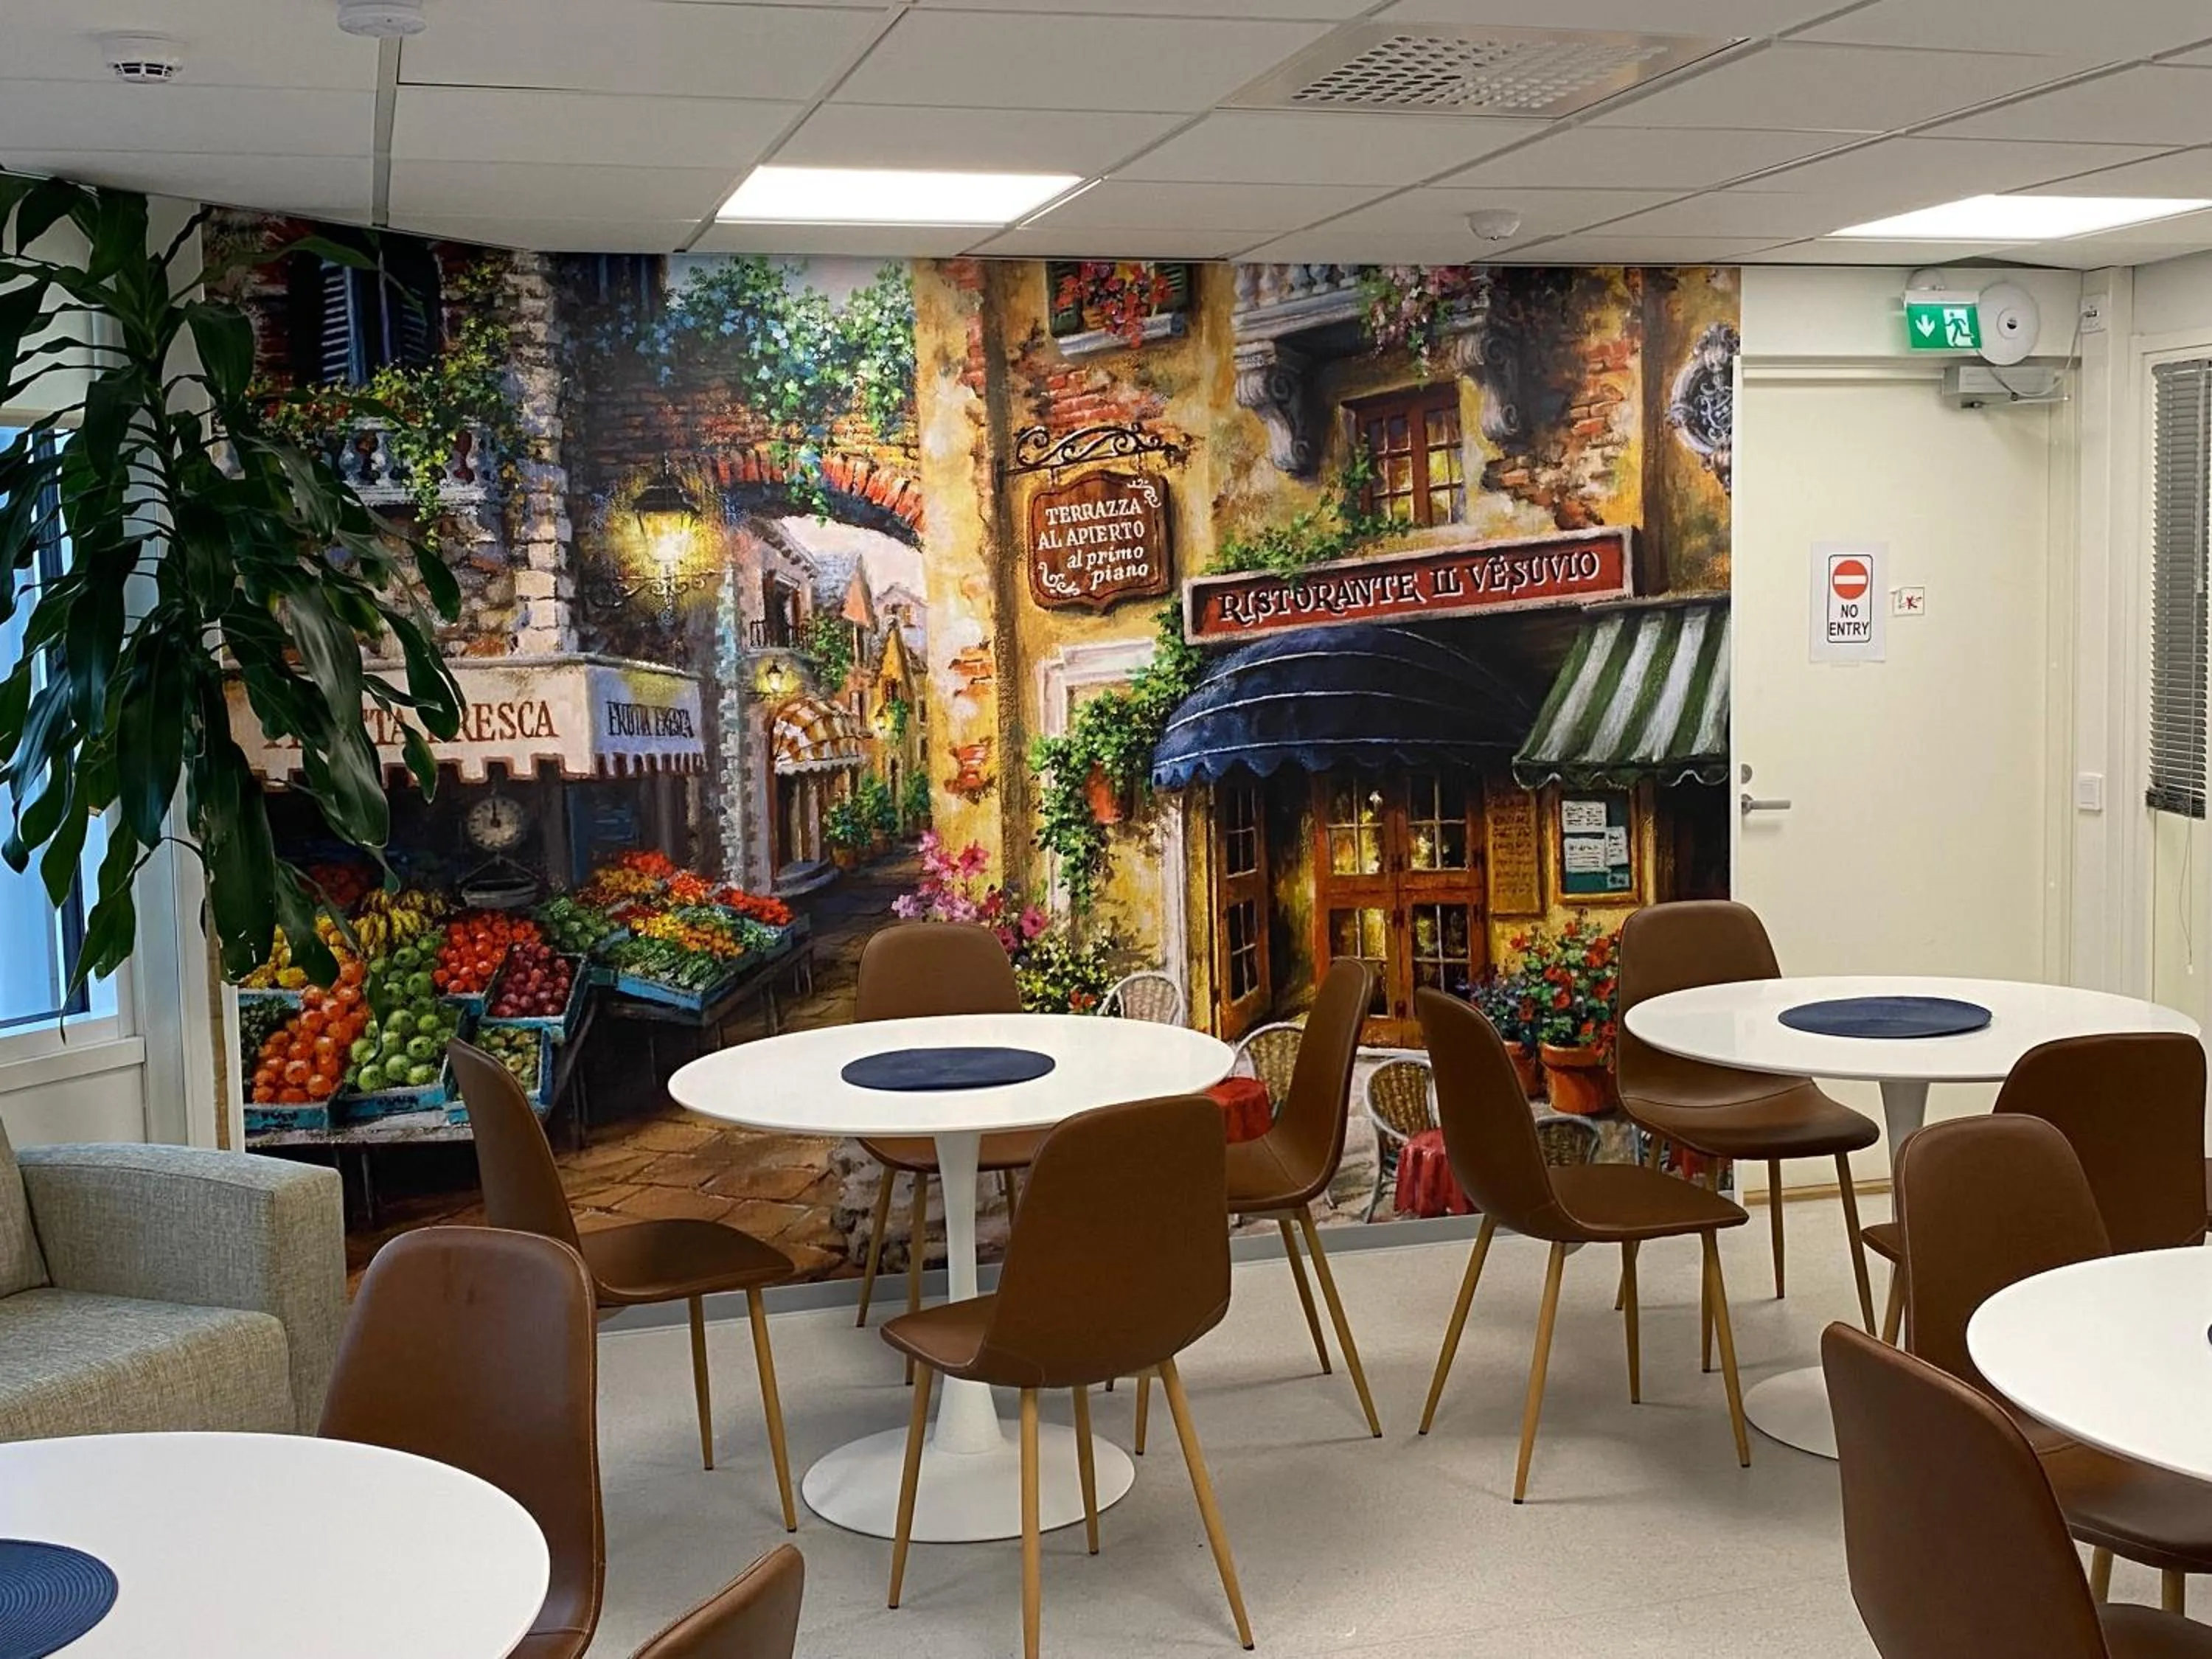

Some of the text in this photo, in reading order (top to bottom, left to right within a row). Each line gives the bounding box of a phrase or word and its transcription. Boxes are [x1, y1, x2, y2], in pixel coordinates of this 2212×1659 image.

[1045, 497, 1143, 525] TERRAZZA
[1037, 521, 1145, 551] AL APIERTO
[1067, 546, 1144, 571] al primo
[1090, 563, 1149, 591] piano
[1217, 571, 1427, 627] RISTORANTE
[1430, 566, 1464, 598] IL
[1840, 604, 1859, 619] NO
[1829, 622, 1870, 636] ENTRY
